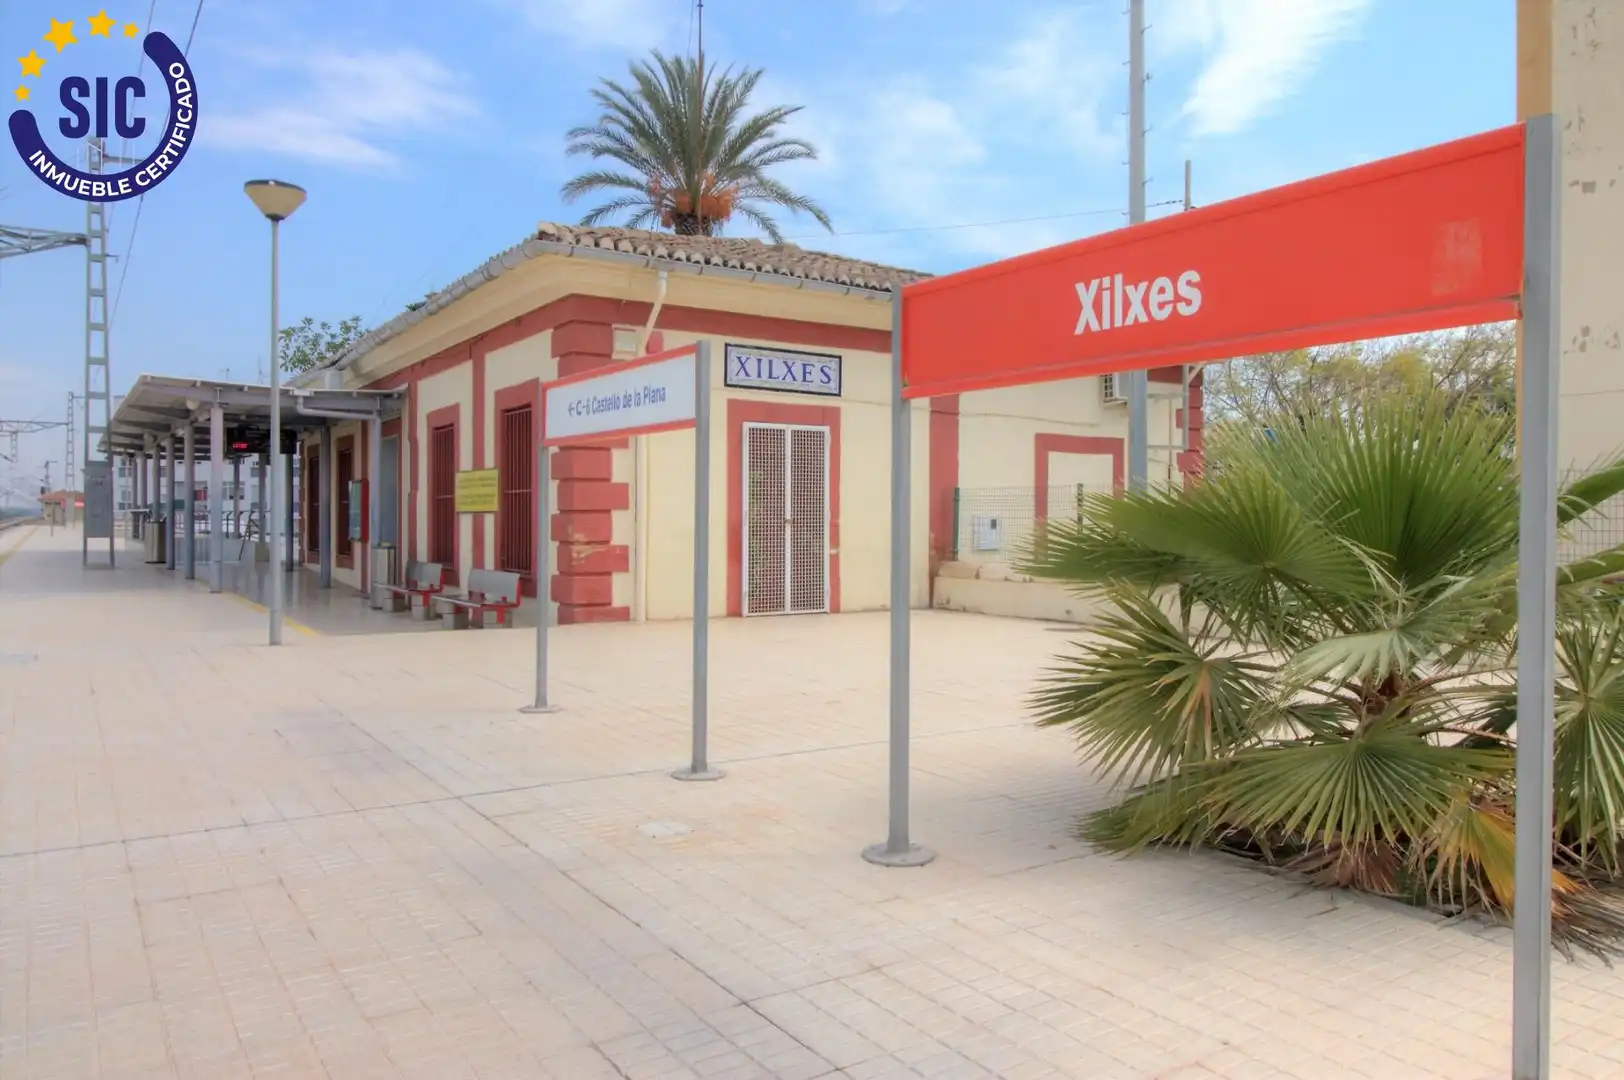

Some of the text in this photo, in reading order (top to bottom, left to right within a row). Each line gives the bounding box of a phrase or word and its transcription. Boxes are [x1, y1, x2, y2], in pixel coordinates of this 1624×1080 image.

[1074, 270, 1202, 336] Xilxes
[735, 355, 832, 385] XILXES
[622, 389, 633, 409] de
[634, 387, 641, 407] la
[643, 384, 666, 406] Plana
